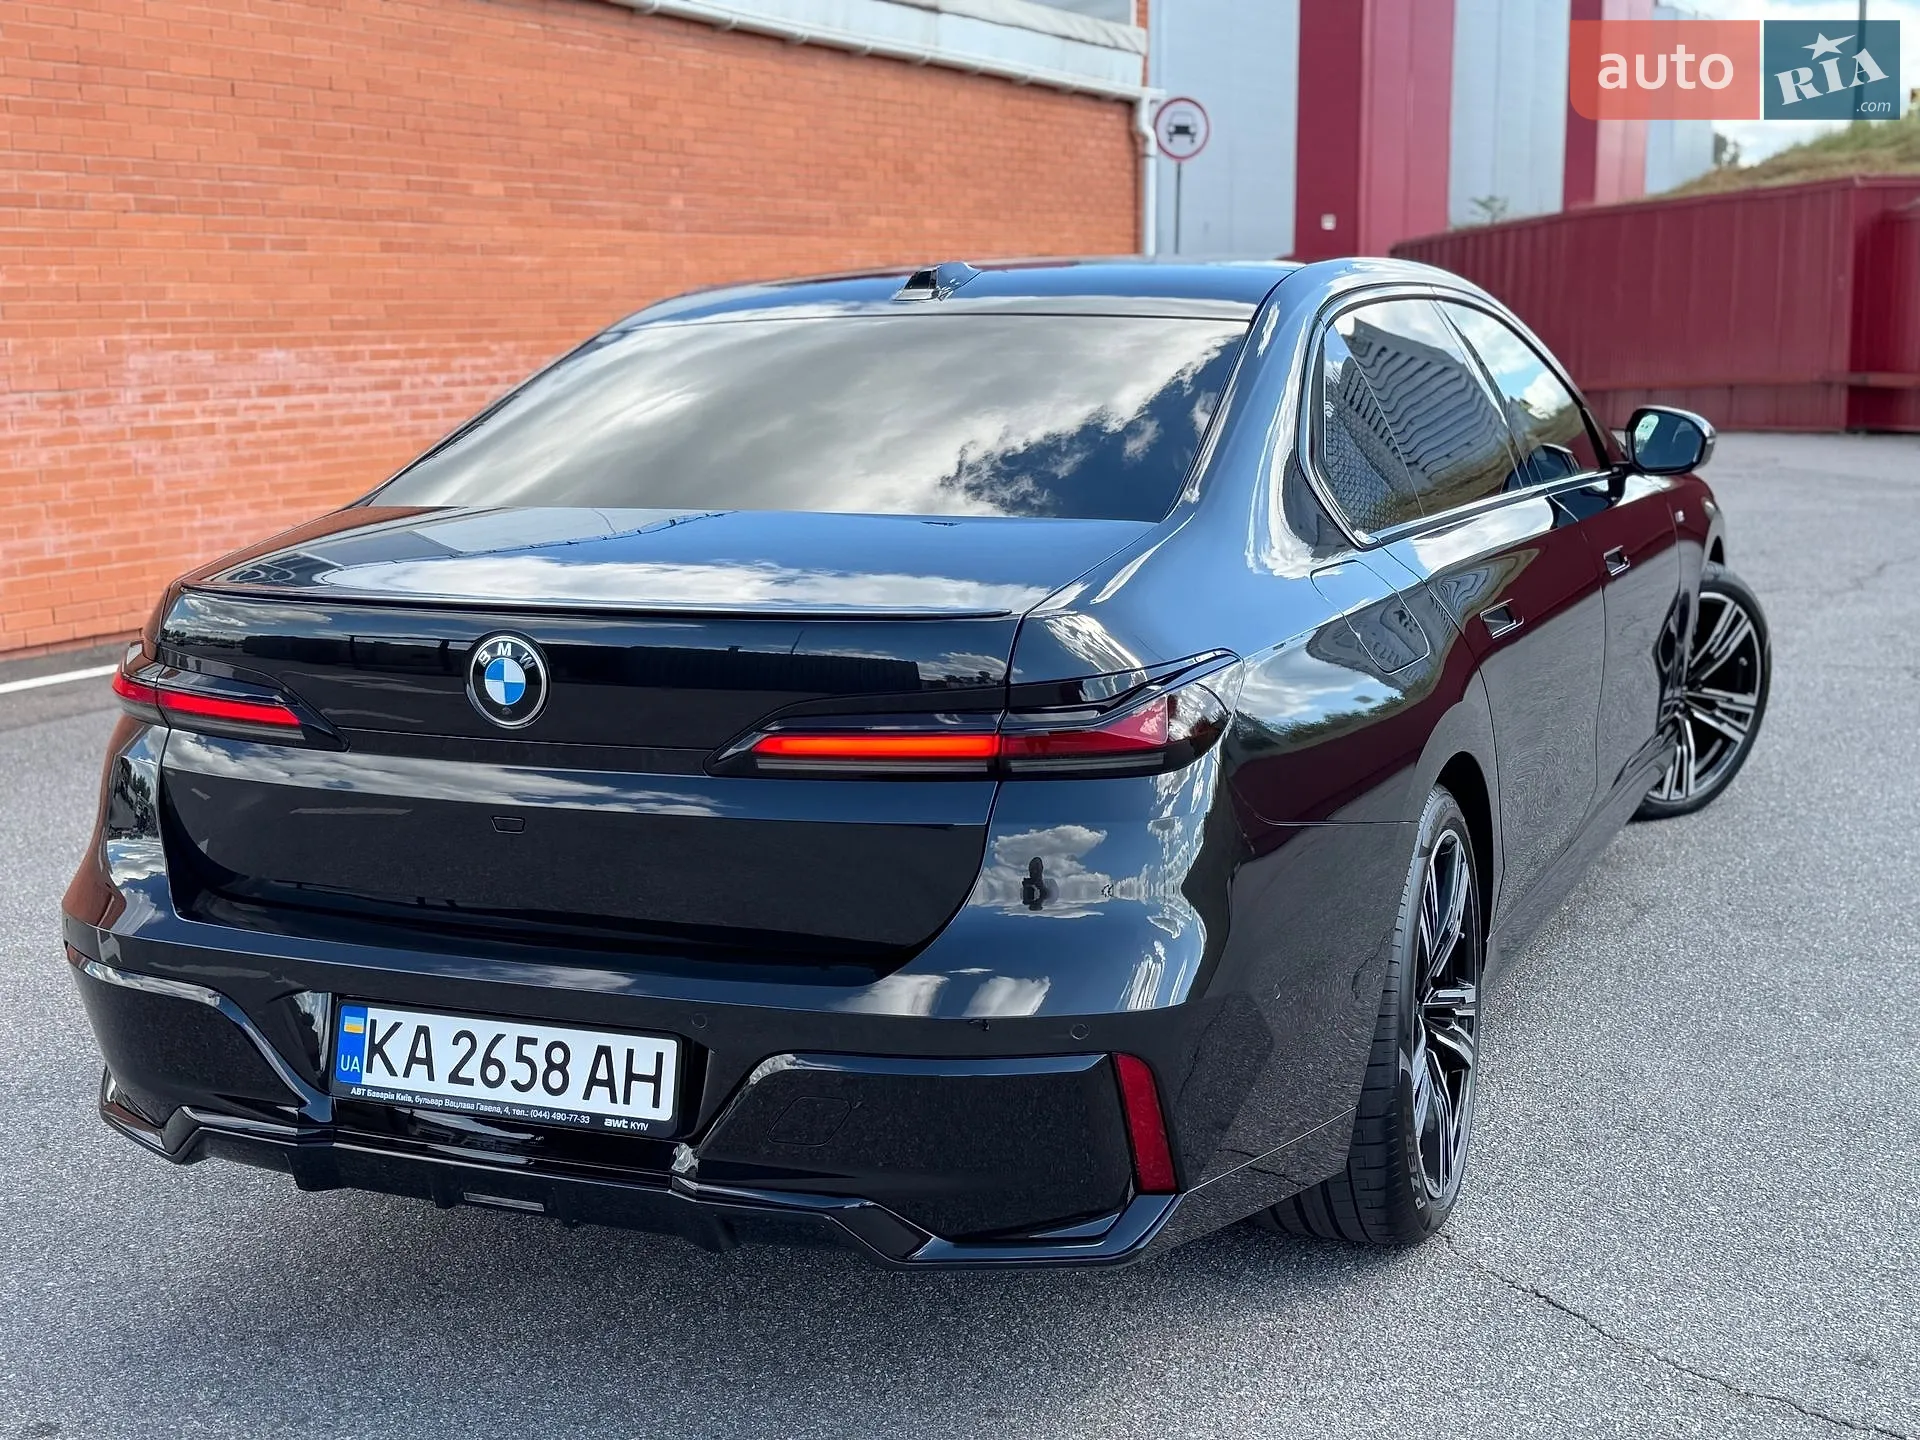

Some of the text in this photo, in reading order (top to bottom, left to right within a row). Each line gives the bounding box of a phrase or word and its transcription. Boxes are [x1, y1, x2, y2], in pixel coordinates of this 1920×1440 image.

[478, 642, 536, 670] BMW
[340, 1055, 360, 1073] UA
[365, 1018, 665, 1109] KA 2658 AH
[350, 1087, 366, 1096] АВТ
[366, 1089, 395, 1101] Баварія
[415, 1095, 444, 1107] бульвар
[530, 1109, 550, 1121] (044)
[551, 1111, 590, 1124] 490-77-33
[604, 1117, 649, 1131] awt KYIV
